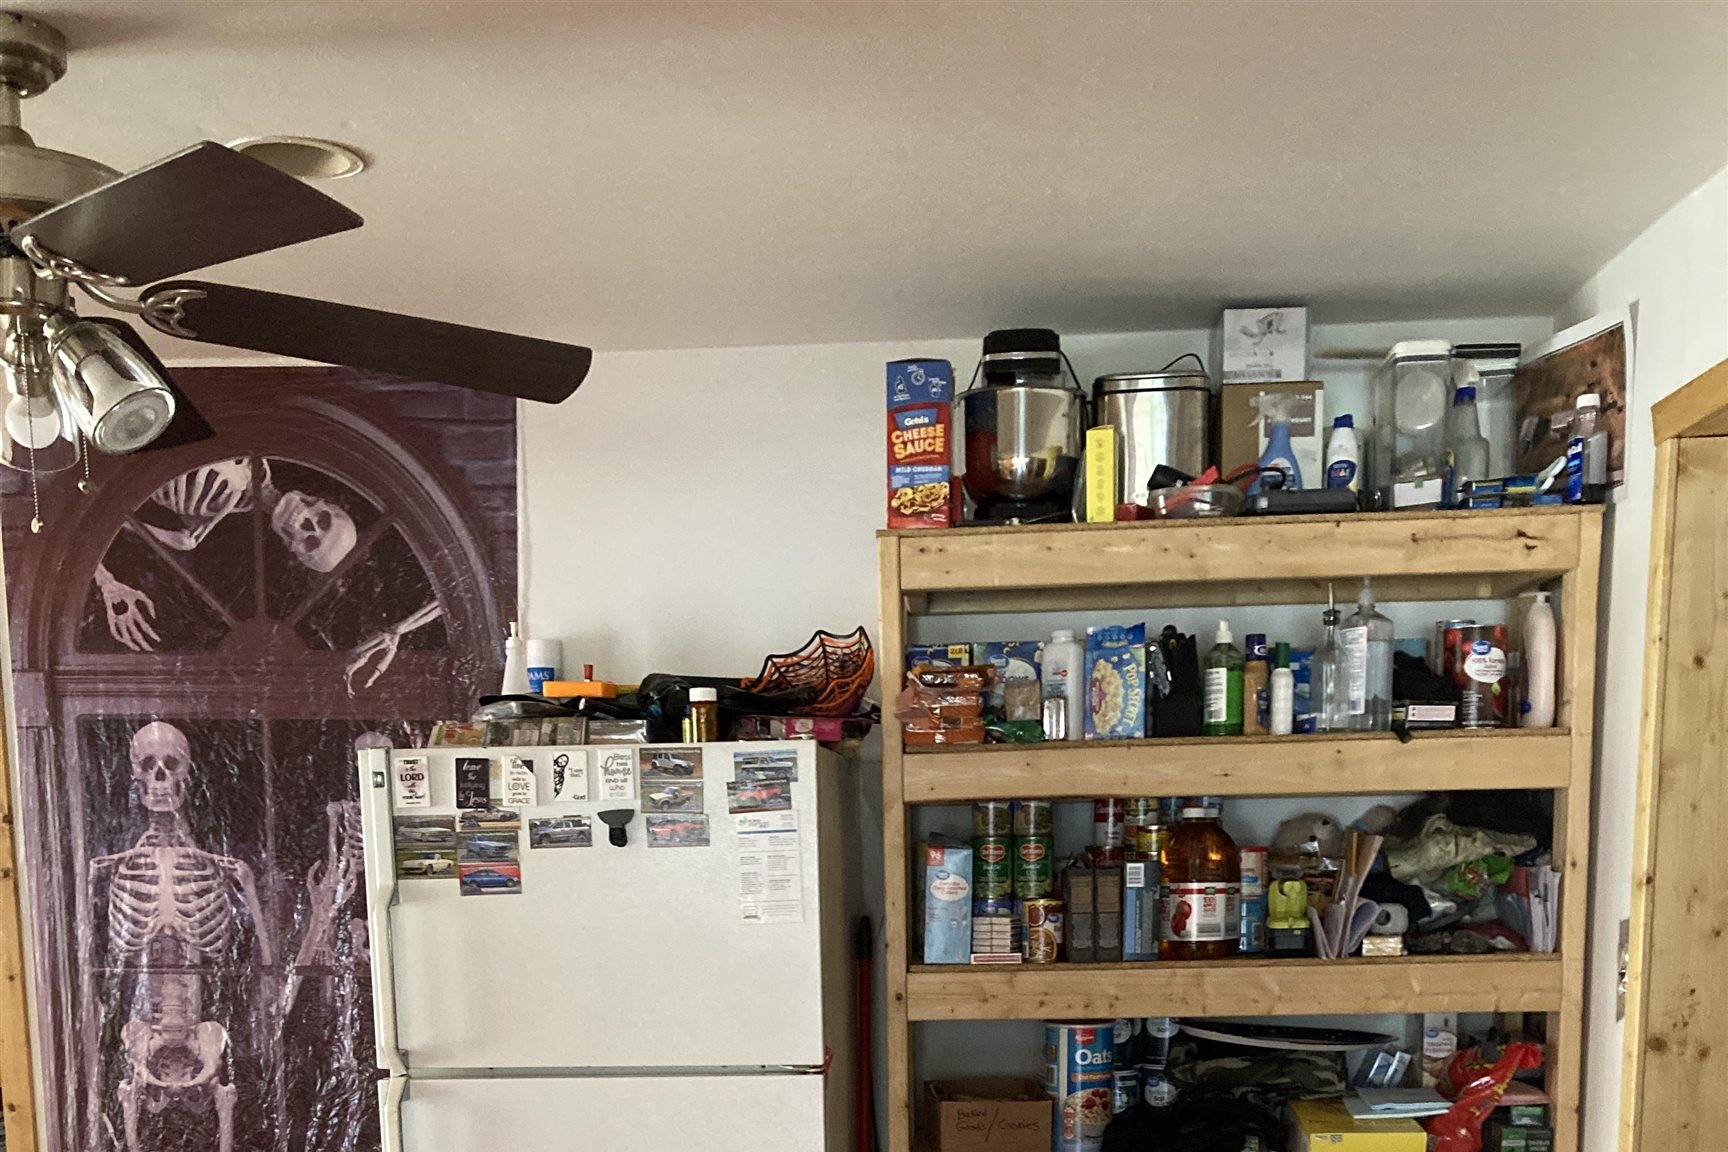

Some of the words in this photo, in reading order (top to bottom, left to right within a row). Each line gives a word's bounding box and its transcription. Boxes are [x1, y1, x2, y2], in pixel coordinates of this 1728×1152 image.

[891, 424, 945, 444] CHEESE
[893, 438, 945, 460] SAUCE
[1122, 662, 1140, 687] POP
[1122, 687, 1143, 728] SECRET
[400, 773, 425, 782] LORD
[507, 782, 531, 791] LOVE
[929, 851, 942, 860] 96
[1074, 1048, 1113, 1065] Oats
[998, 1118, 1041, 1132] Cookies
